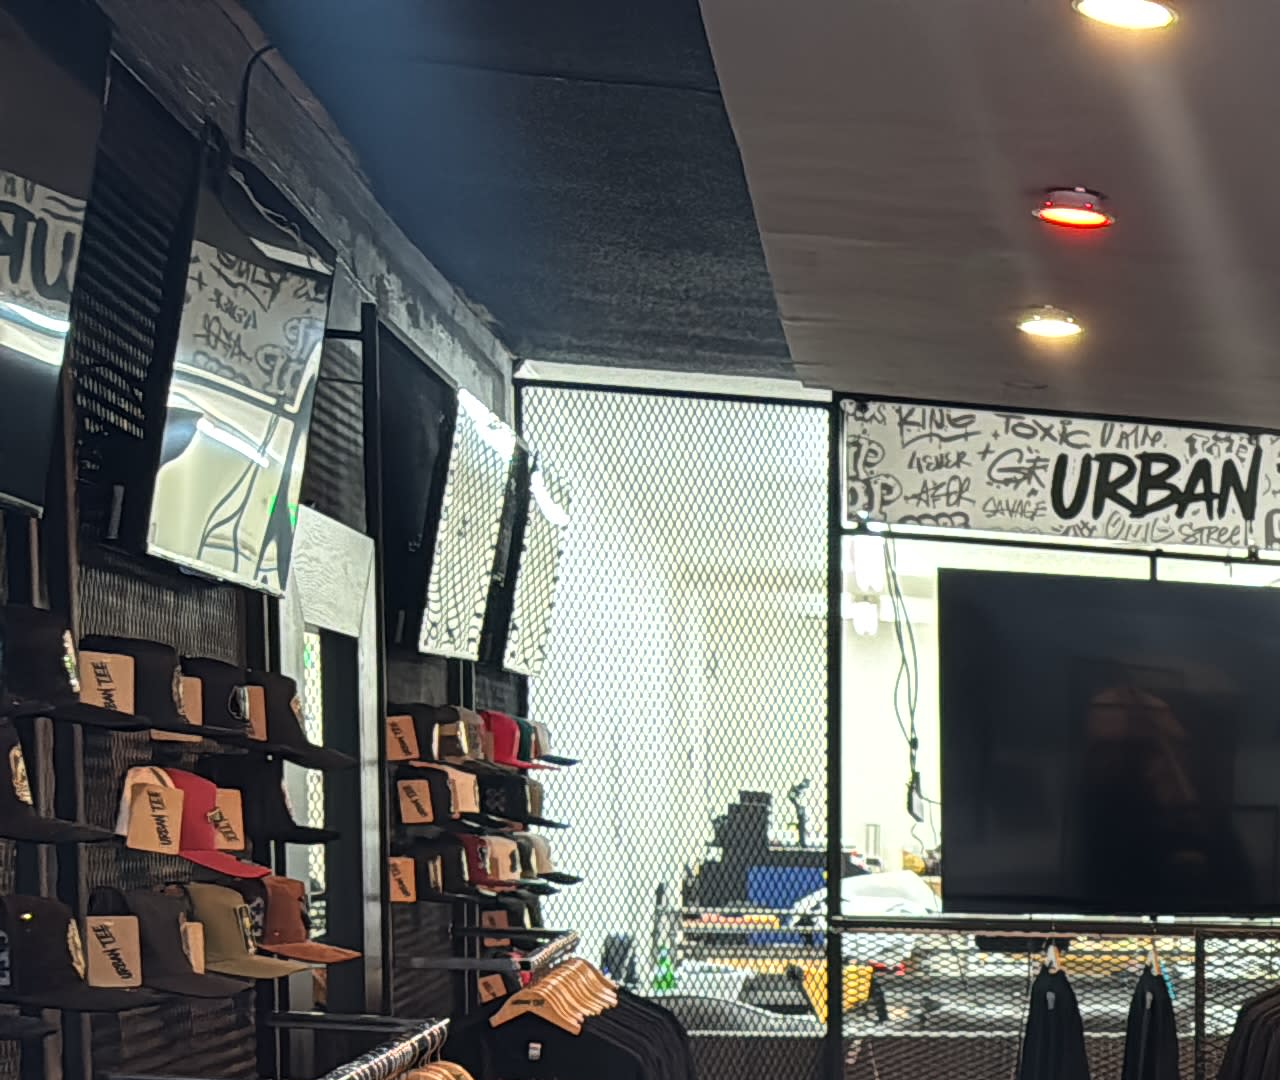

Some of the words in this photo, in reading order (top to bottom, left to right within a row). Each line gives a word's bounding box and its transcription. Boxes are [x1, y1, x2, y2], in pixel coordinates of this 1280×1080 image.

[995, 413, 1091, 449] TOXIC
[1051, 444, 1262, 522] URBAN
[982, 496, 1049, 521] SAVAGE
[91, 661, 115, 690] TEE
[97, 687, 118, 711] BAN
[147, 789, 166, 817] TEE
